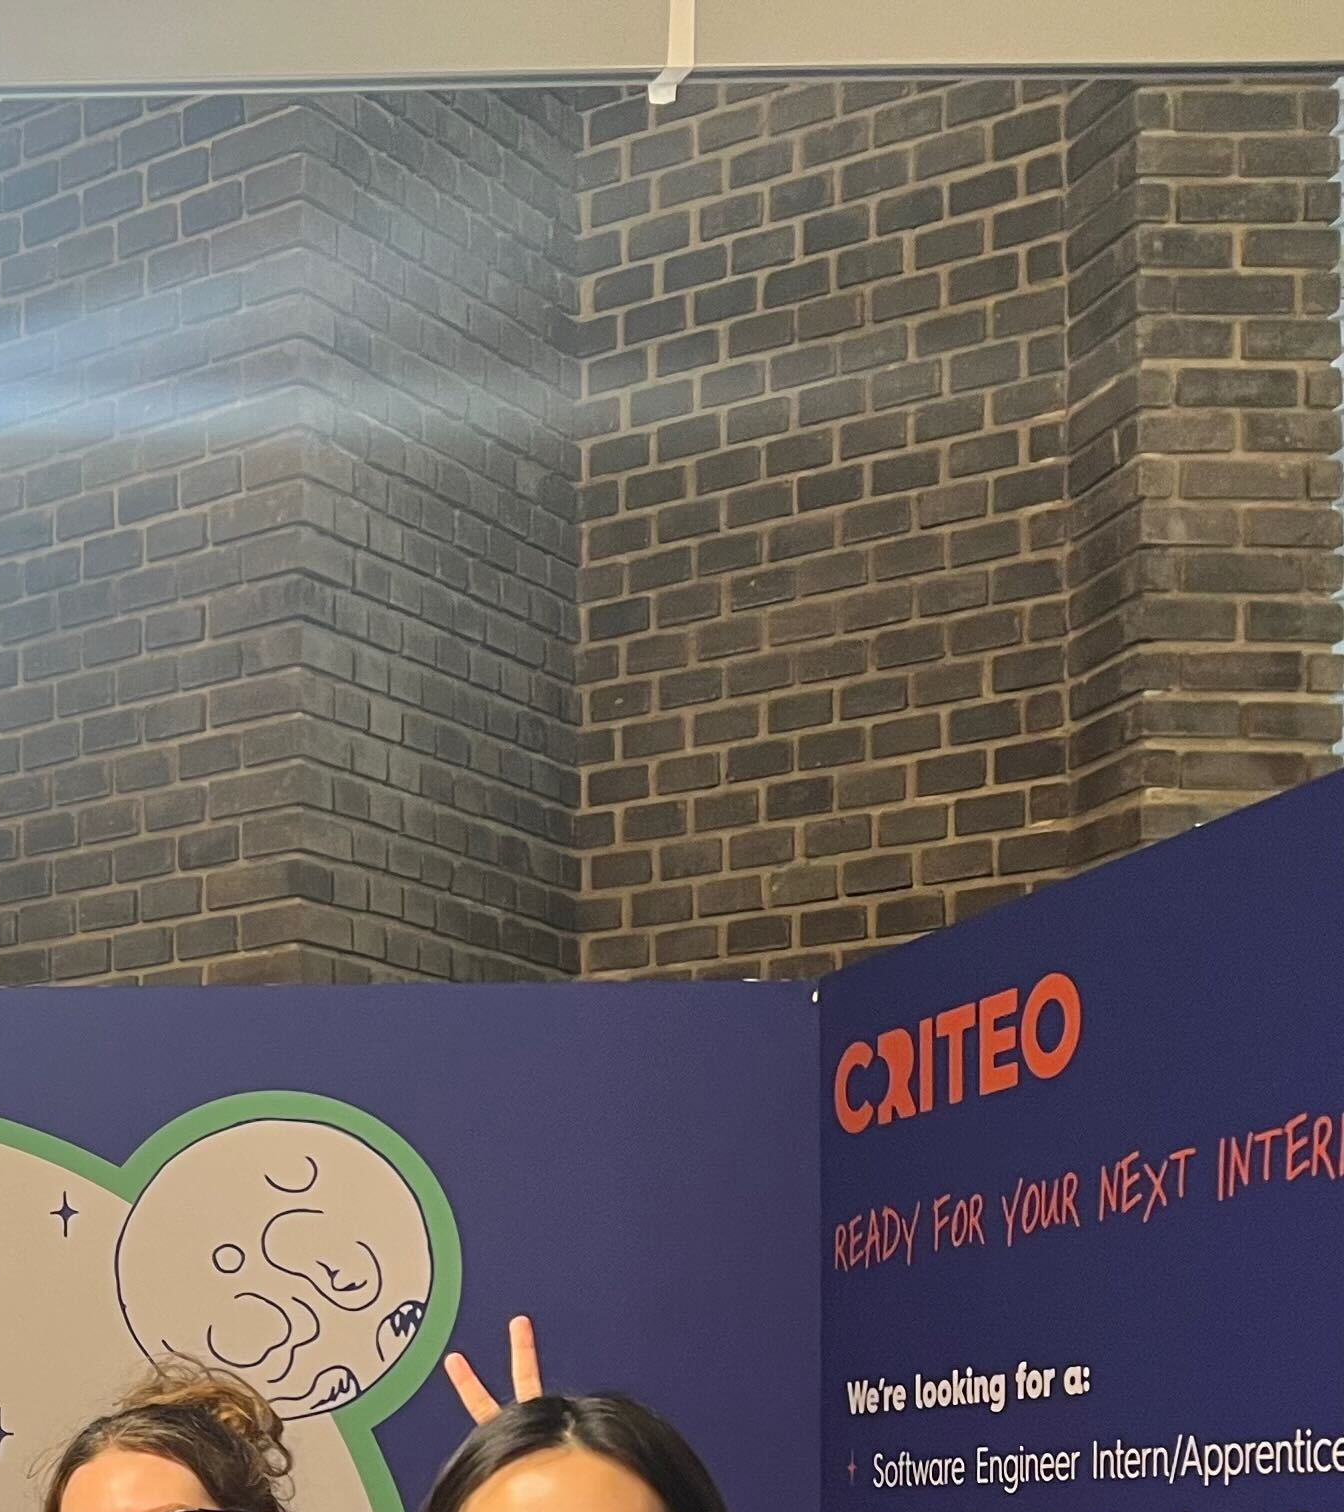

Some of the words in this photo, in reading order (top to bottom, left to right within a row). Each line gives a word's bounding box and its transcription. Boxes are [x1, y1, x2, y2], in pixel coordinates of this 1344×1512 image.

[834, 972, 1082, 1134] CRITEO
[834, 1201, 920, 1271] READY
[933, 1192, 985, 1252] FOR
[1001, 1172, 1079, 1247] YOUR
[1099, 1150, 1197, 1223] NEXT
[1217, 1111, 1344, 1201] INTER
[915, 1367, 1006, 1412] looking
[1015, 1361, 1055, 1399] for
[1064, 1365, 1091, 1395] a:
[872, 1450, 965, 1488] Software
[976, 1446, 1080, 1494] Engineer
[1092, 1428, 1344, 1486] Intern/Apprentice
